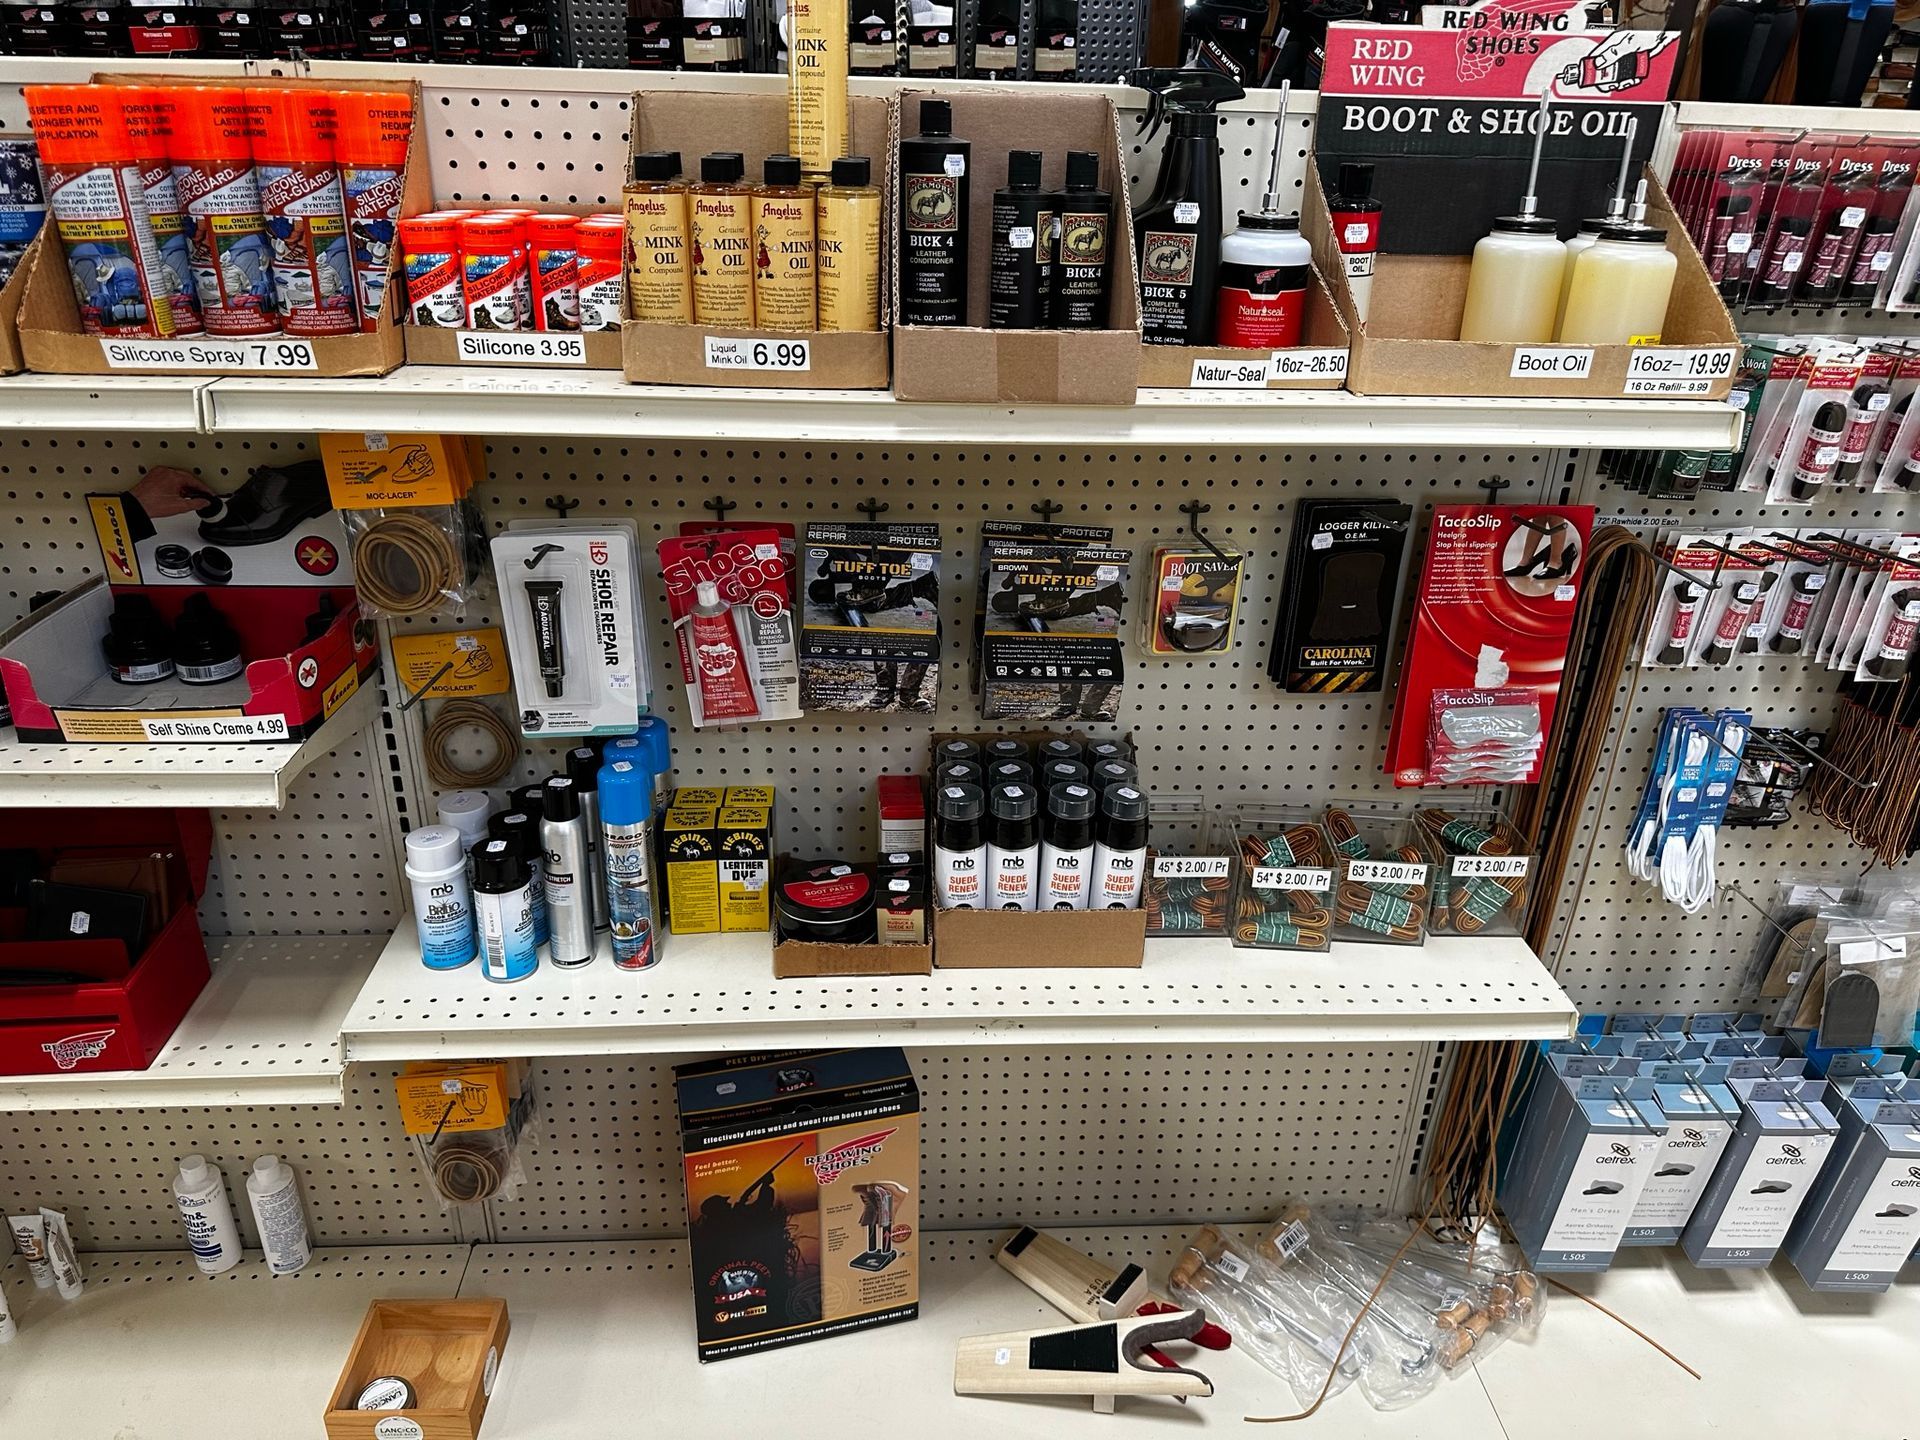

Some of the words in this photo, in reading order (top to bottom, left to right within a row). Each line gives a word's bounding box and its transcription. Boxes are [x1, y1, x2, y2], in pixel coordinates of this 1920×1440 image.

[1442, 10, 1488, 30] RED
[1499, 11, 1570, 31] WING
[1352, 38, 1413, 60] RED
[1465, 36, 1540, 56] SHOES
[797, 55, 821, 67] OIL
[1207, 40, 1222, 57] RED
[1219, 53, 1241, 75] WING
[1350, 64, 1426, 87] WING
[35, 105, 73, 115] BETTER
[76, 104, 99, 114] AND
[1343, 105, 1440, 133] BOOT
[1447, 109, 1472, 133] &
[1480, 109, 1574, 136] SHOE
[1727, 155, 1763, 169] Dress
[1794, 157, 1822, 170] Dress
[1839, 158, 1874, 172] Dress
[1881, 160, 1911, 173] Dress
[87, 174, 113, 182] SUEDE
[76, 182, 115, 190] LEATHER
[628, 198, 667, 214] Angelus
[644, 236, 684, 249] MINK
[713, 238, 750, 251] MINK
[910, 235, 943, 248] BICK
[946, 235, 955, 248] 4
[653, 252, 680, 265] OIL
[722, 254, 746, 266] OIL
[915, 250, 947, 258] LEATHER
[1349, 256, 1370, 265] BOOT
[909, 257, 954, 265] CONDITIONER
[1352, 265, 1365, 273] OIL
[1143, 286, 1175, 298] BICK
[1179, 287, 1187, 299] 5
[463, 337, 536, 356] Silicone
[540, 339, 582, 357] 3.95
[710, 343, 738, 354] Liquid
[110, 344, 186, 364] Silicone
[191, 346, 246, 367] Spray
[252, 344, 311, 366] 7.99
[711, 354, 733, 365] Mink
[734, 354, 748, 365] Oil
[752, 343, 807, 367] 6.99
[1196, 365, 1267, 382] Natur-Seal
[1275, 355, 1346, 374] 16oz-26.50
[1517, 355, 1559, 372] Boot
[1562, 355, 1587, 372] Oil
[1633, 356, 1683, 373] 16oz-
[1688, 352, 1732, 375] 19.99
[1746, 358, 1767, 371] Work
[1630, 382, 1641, 392] 16
[1644, 382, 1656, 392] Oz
[1688, 382, 1709, 392] 9.99
[1318, 521, 1361, 531] LOGGER
[1437, 514, 1502, 531] TaccoSlip
[1597, 518, 1610, 526] 72"
[1610, 517, 1643, 526] Rawhide
[1644, 518, 1661, 526] 2.00
[1662, 518, 1680, 526] Each
[107, 504, 134, 578] TARRAGO
[808, 531, 847, 541] REPAIR
[889, 536, 939, 546] PROTECT
[1344, 532, 1369, 540] O.E.M.
[1437, 532, 1467, 540] Heelgrip
[994, 548, 1033, 556] REPAIR
[1076, 550, 1127, 559] PROTECT
[662, 543, 757, 596] Shoe
[833, 561, 877, 575] TUFF
[879, 562, 913, 576] TOE
[997, 564, 1029, 572] BROWN
[1170, 562, 1202, 577] BOOT
[1202, 560, 1239, 574] SAVER
[716, 555, 785, 605] Goo
[1018, 574, 1060, 586] TUFF
[1063, 574, 1098, 587] TOE
[594, 569, 614, 610] SHOE
[540, 611, 551, 650] AQUASEAL
[758, 628, 782, 636] REPAIR
[600, 612, 620, 667] REPAIR
[1303, 647, 1373, 660] CAROLINA
[1441, 693, 1495, 706] TaccoSlip
[147, 723, 173, 737] Self
[176, 723, 211, 736] Shine
[213, 722, 254, 736] Creme
[256, 720, 285, 735] 4.99
[669, 833, 712, 853] FIEBING'S
[722, 832, 764, 851] FIEBING'S
[723, 861, 764, 871] LEATHER
[952, 856, 975, 869] mb
[1002, 855, 1025, 868] mb
[1056, 856, 1079, 868] mb
[1158, 861, 1175, 873] 45"
[1176, 861, 1184, 873] $
[1184, 861, 1206, 873] 2.00
[1214, 862, 1227, 874] Pr
[1457, 860, 1473, 872] 72"
[1475, 861, 1482, 873] $
[1483, 861, 1505, 873] 2.00
[1513, 861, 1526, 874] Pr
[548, 875, 572, 883] STRETCH
[731, 870, 757, 881] DYE
[949, 875, 978, 885] SUEDE
[999, 874, 1028, 884] SUEDE
[1052, 873, 1081, 883] SUEDE
[1256, 872, 1274, 885] 54"
[1276, 872, 1284, 884] $
[1284, 873, 1307, 885] 2.00
[1316, 874, 1329, 886] Pr
[1351, 865, 1369, 877] 63"
[1371, 866, 1379, 878] $
[1380, 866, 1402, 879] 2.00
[1411, 869, 1424, 882] Pr
[430, 883, 454, 897] mb
[804, 888, 828, 897] BOOT
[828, 884, 856, 894] PASTE
[948, 883, 979, 893] RENEW
[997, 882, 1029, 892] RENEW
[1050, 882, 1081, 892] RENEW
[41, 1043, 68, 1052] RED
[71, 1041, 105, 1051] WING
[58, 1049, 99, 1058] SHOES
[703, 1131, 745, 1145] Effectively
[745, 1126, 766, 1138] dries
[767, 1124, 782, 1133] wet
[782, 1122, 798, 1130] and
[798, 1118, 822, 1128] sweat
[822, 1115, 840, 1124] from
[840, 1110, 863, 1121] boots
[864, 1108, 878, 1116] and
[878, 1104, 901, 1114] shoes
[1667, 1138, 1709, 1149] aetrex
[804, 1153, 836, 1166] RED
[839, 1144, 882, 1160] WING
[1595, 1155, 1637, 1166] aetrex
[1765, 1155, 1807, 1166] aetrex
[694, 1162, 711, 1171] Feel
[712, 1158, 739, 1168] better.
[819, 1157, 871, 1173] SHOES
[694, 1170, 713, 1178] Save
[714, 1165, 742, 1176] money.
[728, 1288, 752, 1301] USA
